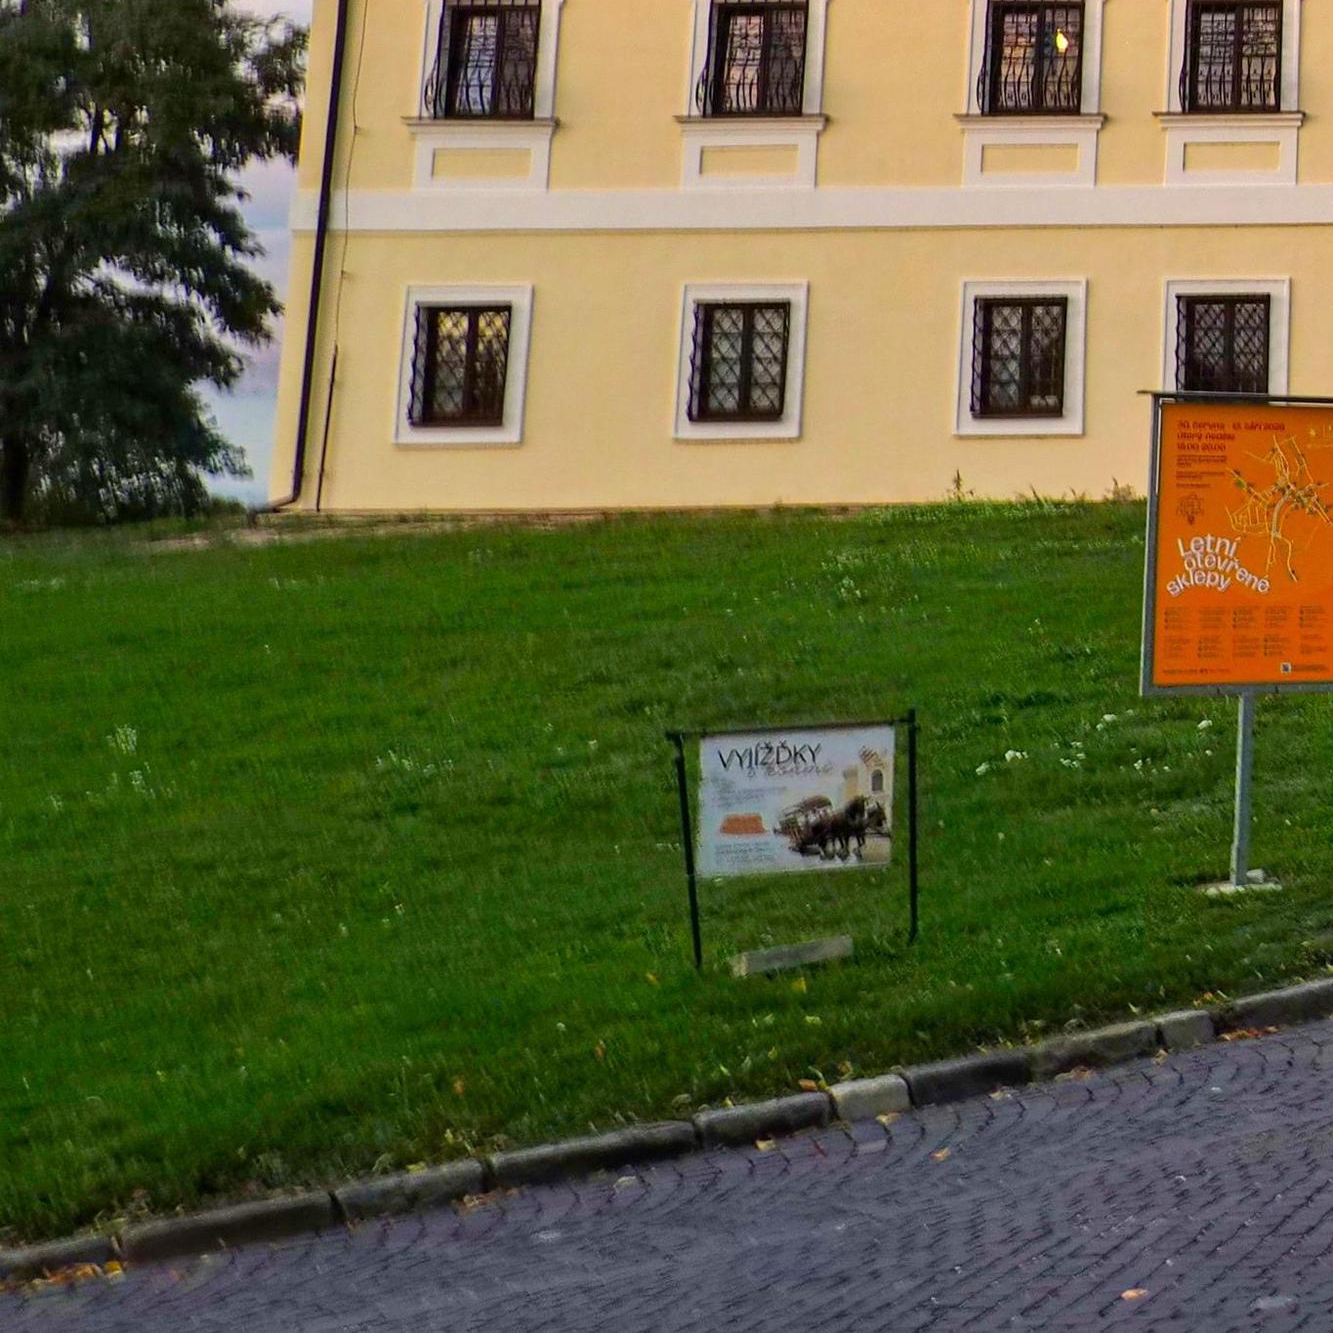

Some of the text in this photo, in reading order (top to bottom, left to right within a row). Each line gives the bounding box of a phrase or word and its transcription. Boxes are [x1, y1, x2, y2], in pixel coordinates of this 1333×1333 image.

[1177, 533, 1242, 558] Letní
[1166, 569, 1232, 597] sklepy
[1184, 552, 1271, 594] otevřené
